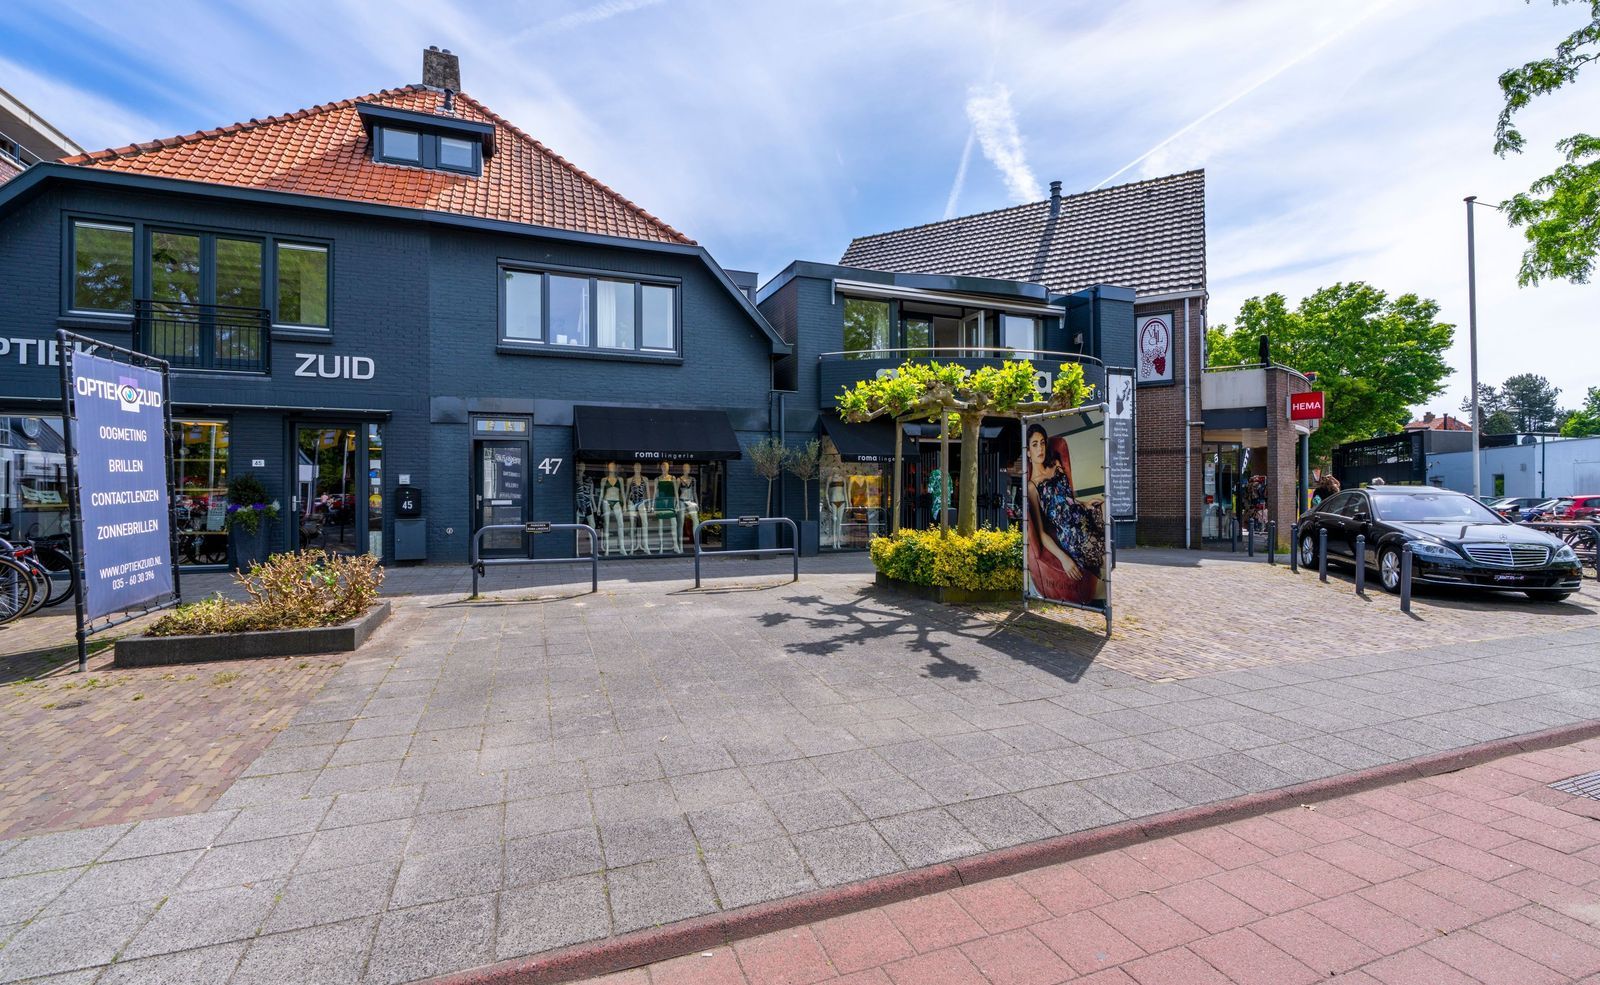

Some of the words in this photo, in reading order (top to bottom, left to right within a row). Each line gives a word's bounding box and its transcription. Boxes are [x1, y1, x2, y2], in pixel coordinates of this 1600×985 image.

[295, 353, 375, 379] ZUID
[77, 376, 121, 401] OPTIEK
[137, 388, 161, 408] ZUID
[1292, 401, 1321, 411] HEMA
[100, 425, 147, 442] OOGMETING
[661, 452, 694, 460] lingerie
[108, 459, 144, 473] BRILLEN
[538, 457, 563, 475] 47
[91, 489, 160, 507] CONTACTLENZEN
[402, 500, 413, 510] 45
[97, 519, 159, 540] ZONNEBRILLEN
[99, 555, 163, 580] WWW.OPTIEKZUID.NL
[112, 577, 125, 590] 035
[129, 574, 137, 586] 60
[136, 572, 145, 584] 30
